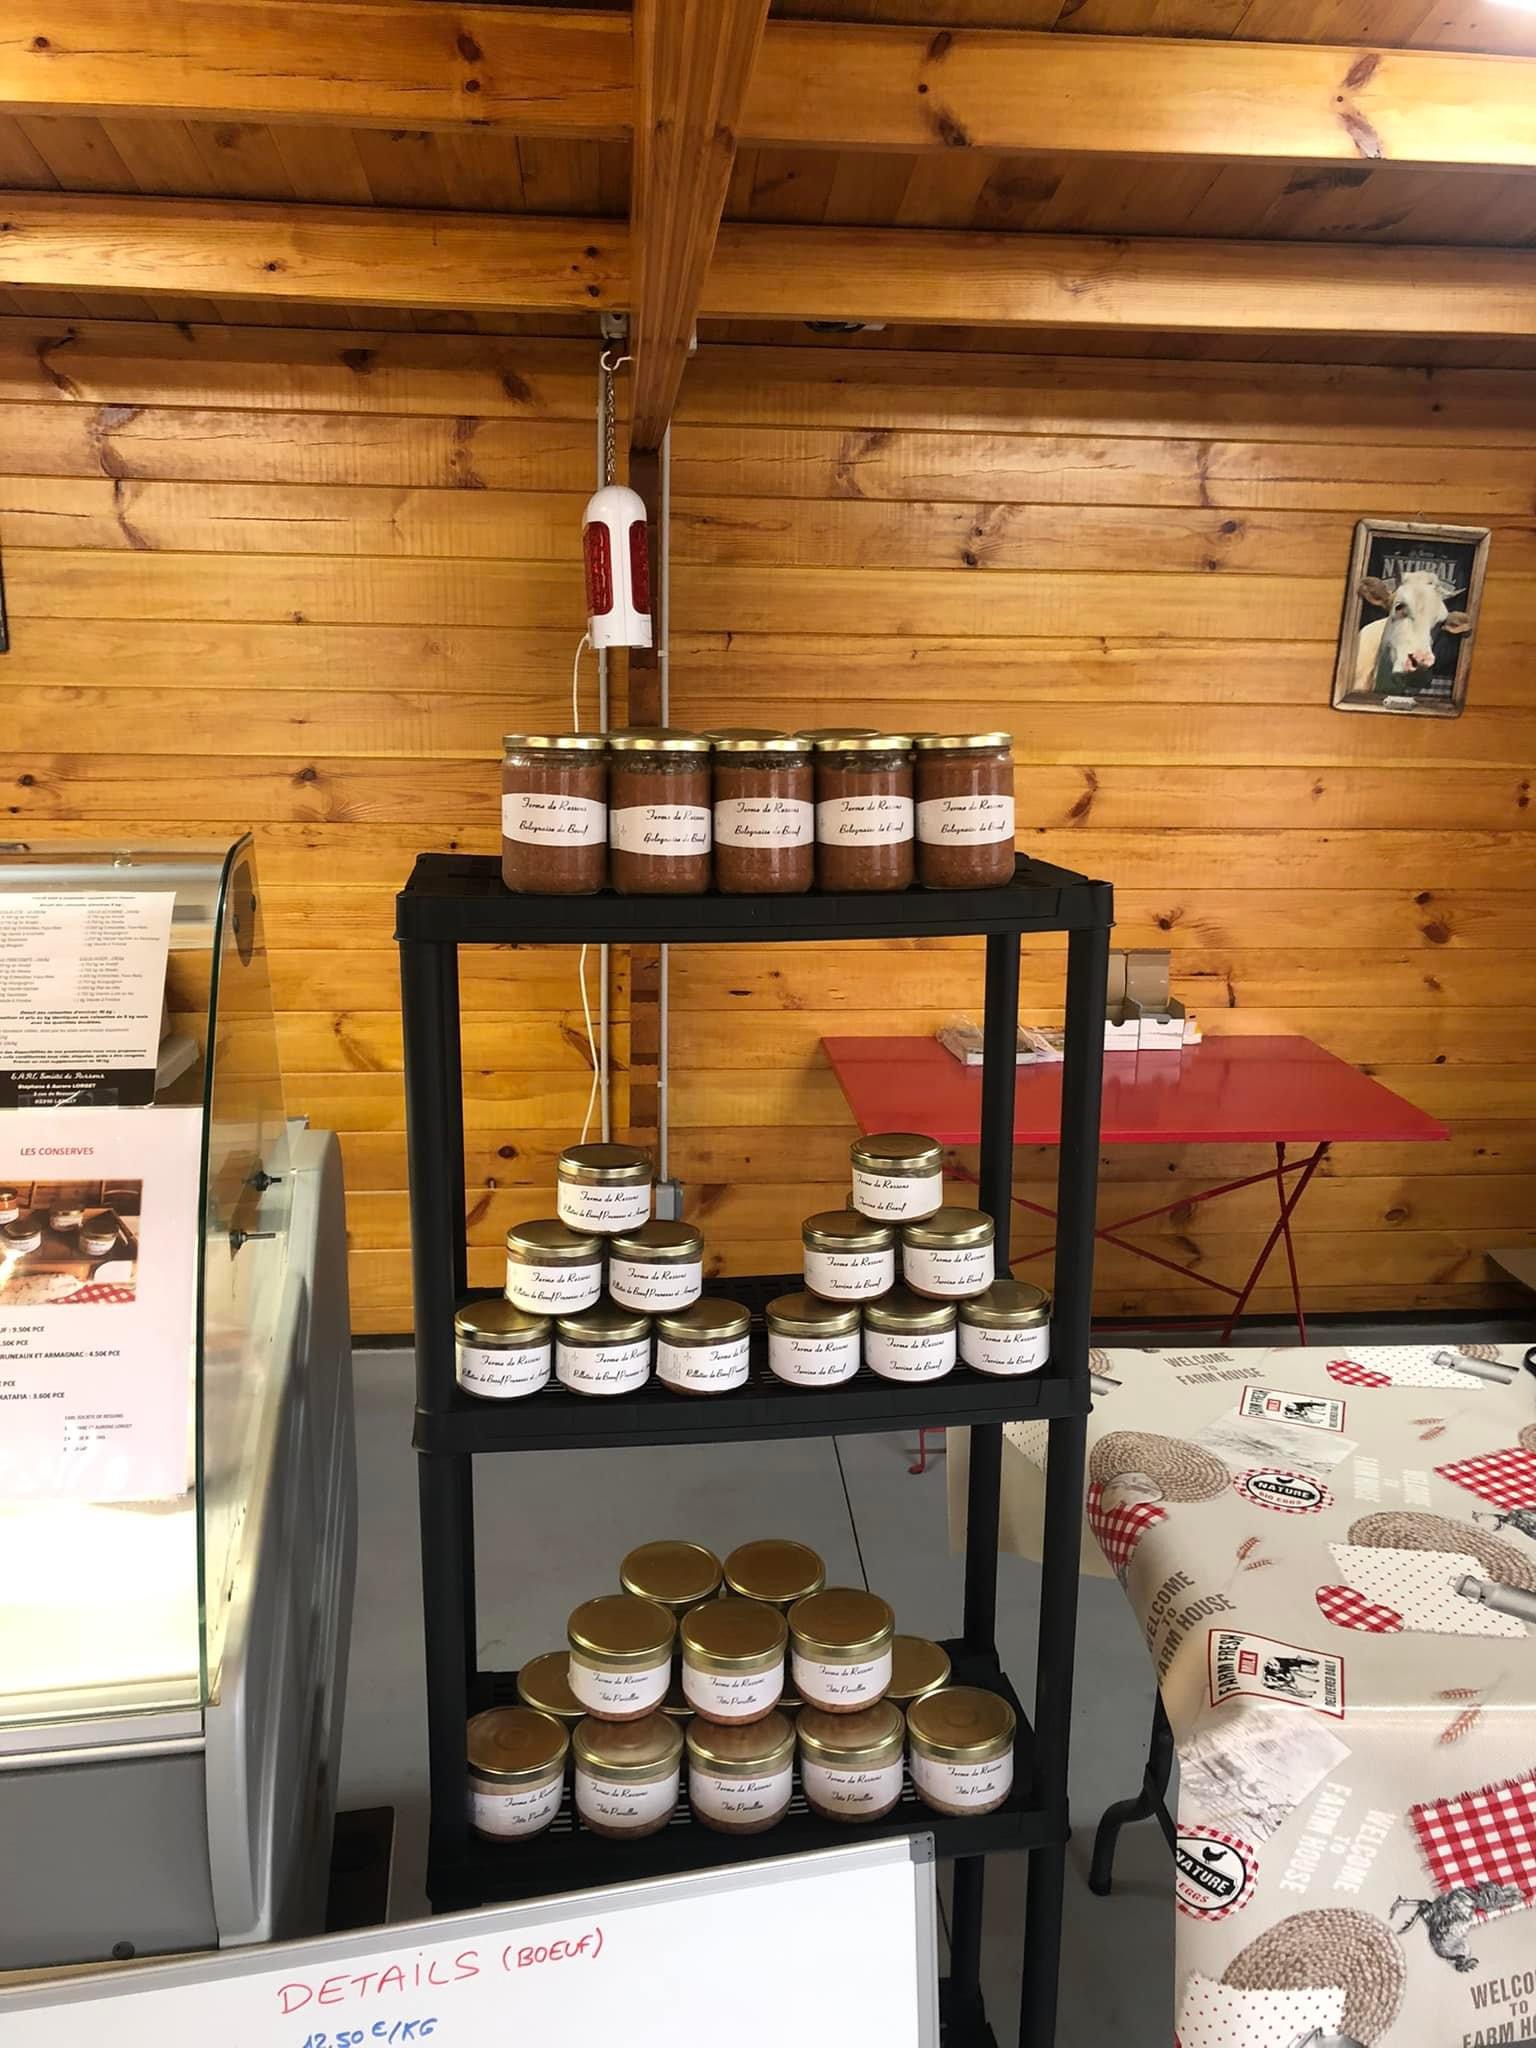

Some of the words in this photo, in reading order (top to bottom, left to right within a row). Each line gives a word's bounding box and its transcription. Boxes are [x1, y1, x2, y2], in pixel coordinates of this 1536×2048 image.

[522, 798, 545, 809] Ferme
[548, 801, 556, 810] de
[736, 802, 760, 813] Ferme
[762, 803, 770, 812] de
[841, 801, 865, 812] Ferme
[943, 801, 967, 812] Ferme
[673, 812, 681, 821] de
[39, 1147, 94, 1155] CONSERVES
[857, 1174, 872, 1185] Ferme
[882, 1180, 909, 1188] Ressons
[581, 1190, 602, 1201] Ferme
[605, 1194, 611, 1202] de
[827, 1257, 848, 1266] Ferme
[851, 1258, 858, 1267] de
[860, 1256, 884, 1266] Ressons
[929, 1253, 951, 1262] Ferme
[954, 1253, 961, 1262] de
[963, 1252, 986, 1262] Ressons
[627, 1268, 648, 1278] Ferme
[651, 1271, 659, 1280] de
[661, 1270, 687, 1280] Ressons
[933, 1276, 956, 1284] Terrine
[958, 1276, 965, 1284] de
[829, 1280, 852, 1288] Terrine
[855, 1280, 862, 1288] de
[979, 1331, 1000, 1341] Ferme
[1003, 1333, 1011, 1342] de
[1013, 1331, 1037, 1342] Ressons
[791, 1342, 812, 1352] Ferme
[815, 1344, 822, 1352] de
[824, 1342, 848, 1352] Ressons
[886, 1338, 908, 1348] Ferme
[911, 1340, 919, 1348] de
[920, 1338, 944, 1348] Ressons
[481, 1355, 504, 1365] Ferme
[507, 1357, 514, 1365] de
[517, 1356, 541, 1365] Ressons
[982, 1354, 1005, 1364] Terrine
[1007, 1356, 1014, 1364] de
[1163, 1352, 1235, 1368] WELCOME
[794, 1366, 817, 1375] Terrine
[819, 1366, 826, 1375] de
[890, 1361, 913, 1370] Terrine
[915, 1362, 922, 1370] de
[1176, 1372, 1219, 1385] FARM
[1218, 1367, 1265, 1381] HOUSE
[1257, 1481, 1310, 1499] NATURE
[1162, 1607, 1177, 1627] TO
[1176, 1594, 1236, 1631] HOUSE
[1218, 1634, 1245, 1661] FRESH
[842, 1668, 848, 1676] de
[1218, 1664, 1241, 1696] FARM
[972, 1769, 978, 1777] de
[1307, 1782, 1352, 1835] FARM
[1330, 1835, 1351, 1854] TO
[1334, 1810, 1397, 1894] WELCOME
[1279, 1835, 1328, 1894] HOUSE
[1176, 1851, 1230, 1894] NATURE
[1178, 1882, 1209, 1903] EGGS
[502, 1927, 604, 1970] (BOEUF)
[1470, 1969, 1536, 2009] WELCO
[1509, 2001, 1528, 2016] TO
[1463, 2022, 1513, 2048] FARM
